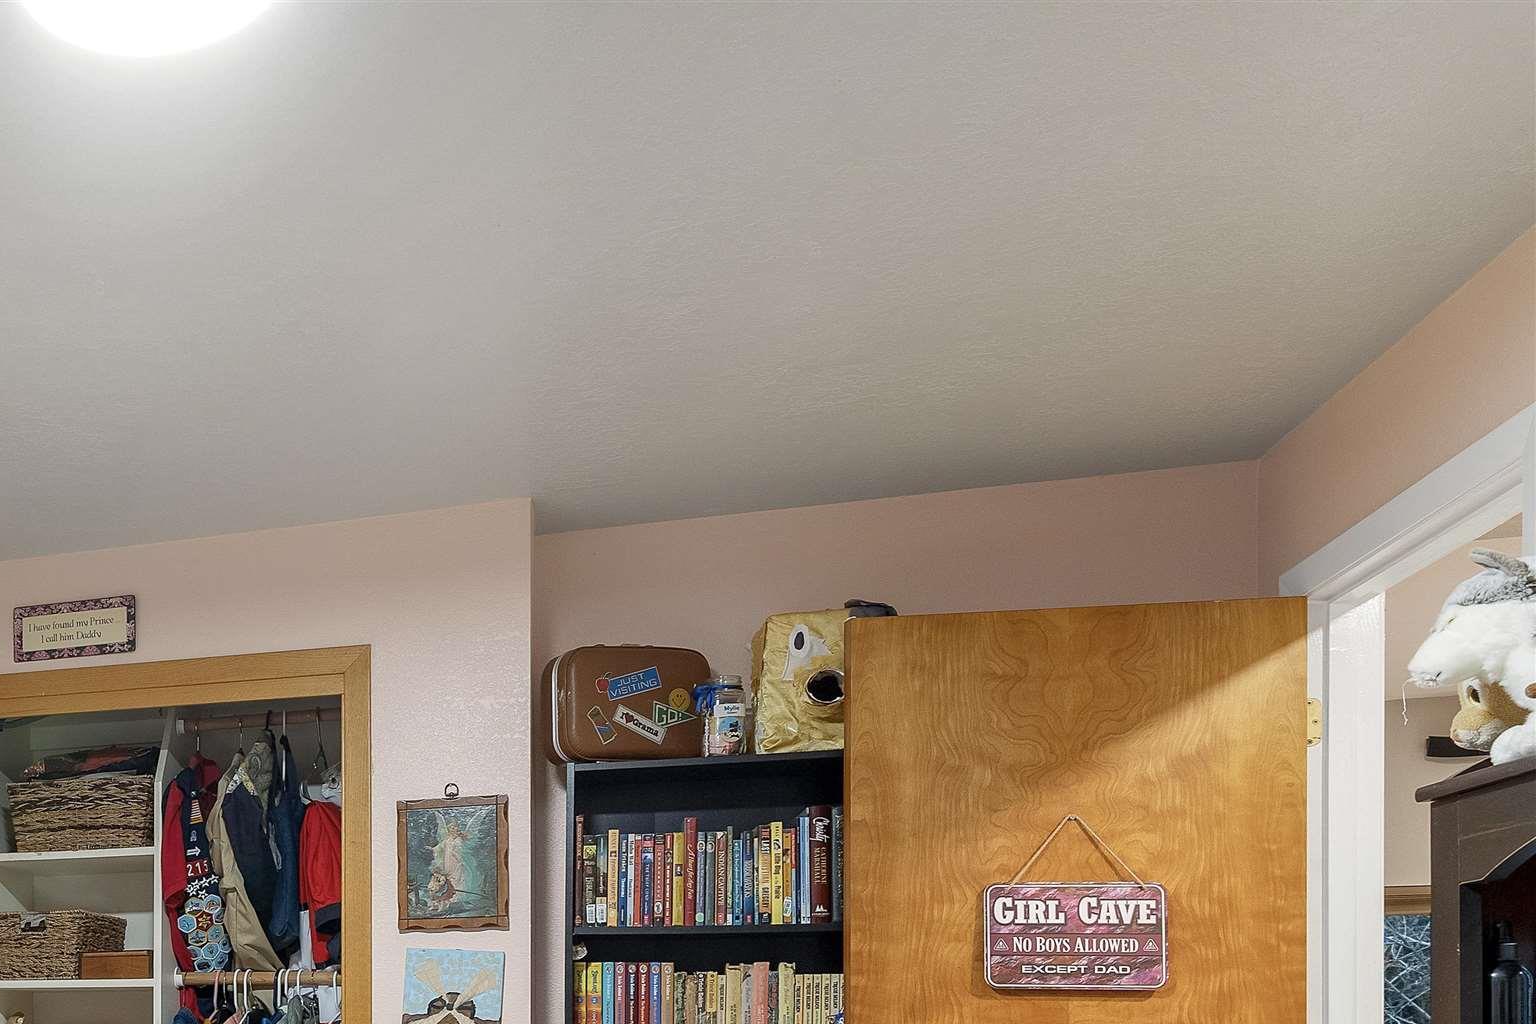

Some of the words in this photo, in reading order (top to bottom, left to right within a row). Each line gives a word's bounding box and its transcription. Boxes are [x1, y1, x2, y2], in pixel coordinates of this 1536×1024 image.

[610, 678, 657, 697] VISITING
[617, 673, 645, 687] JUST
[810, 817, 831, 843] Christy
[993, 896, 1065, 925] GIRL
[1078, 896, 1157, 925] CAVE
[1013, 937, 1032, 953] NO
[1036, 937, 1070, 953] BOYS
[1074, 937, 1139, 953] ALLOWED
[1021, 964, 1087, 975] EXCEPT
[1094, 964, 1131, 975] DAD
